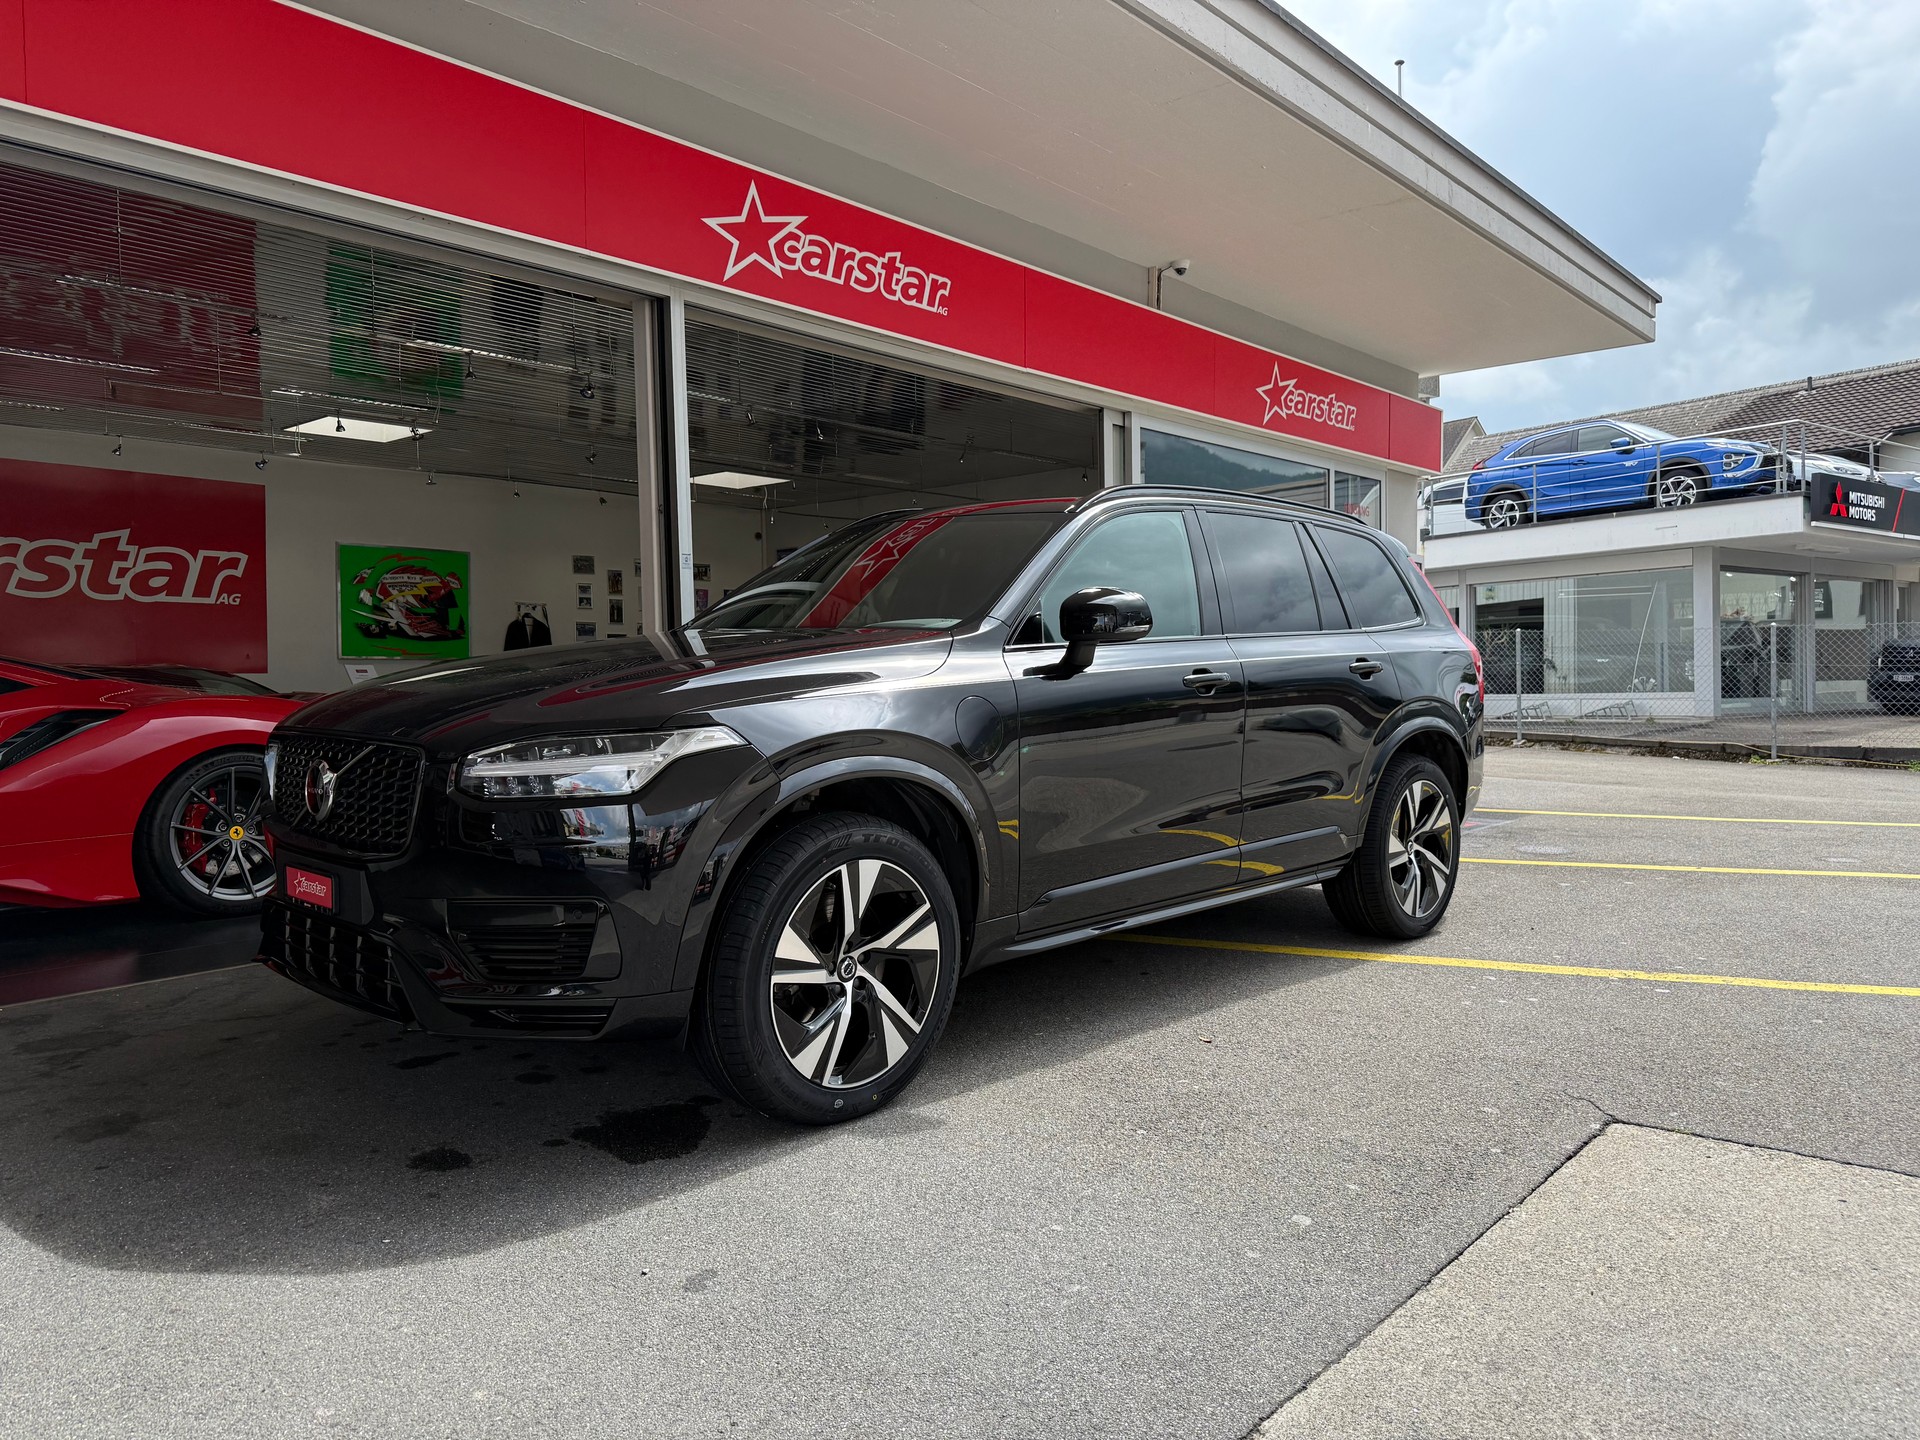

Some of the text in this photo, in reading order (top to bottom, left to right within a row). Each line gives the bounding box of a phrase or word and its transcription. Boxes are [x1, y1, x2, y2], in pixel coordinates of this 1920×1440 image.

[776, 227, 951, 316] carstar AG
[1284, 387, 1357, 430] carstar
[1848, 490, 1885, 509] MITSUBISHI
[1848, 505, 1877, 521] MOTORS
[216, 593, 241, 605] AG
